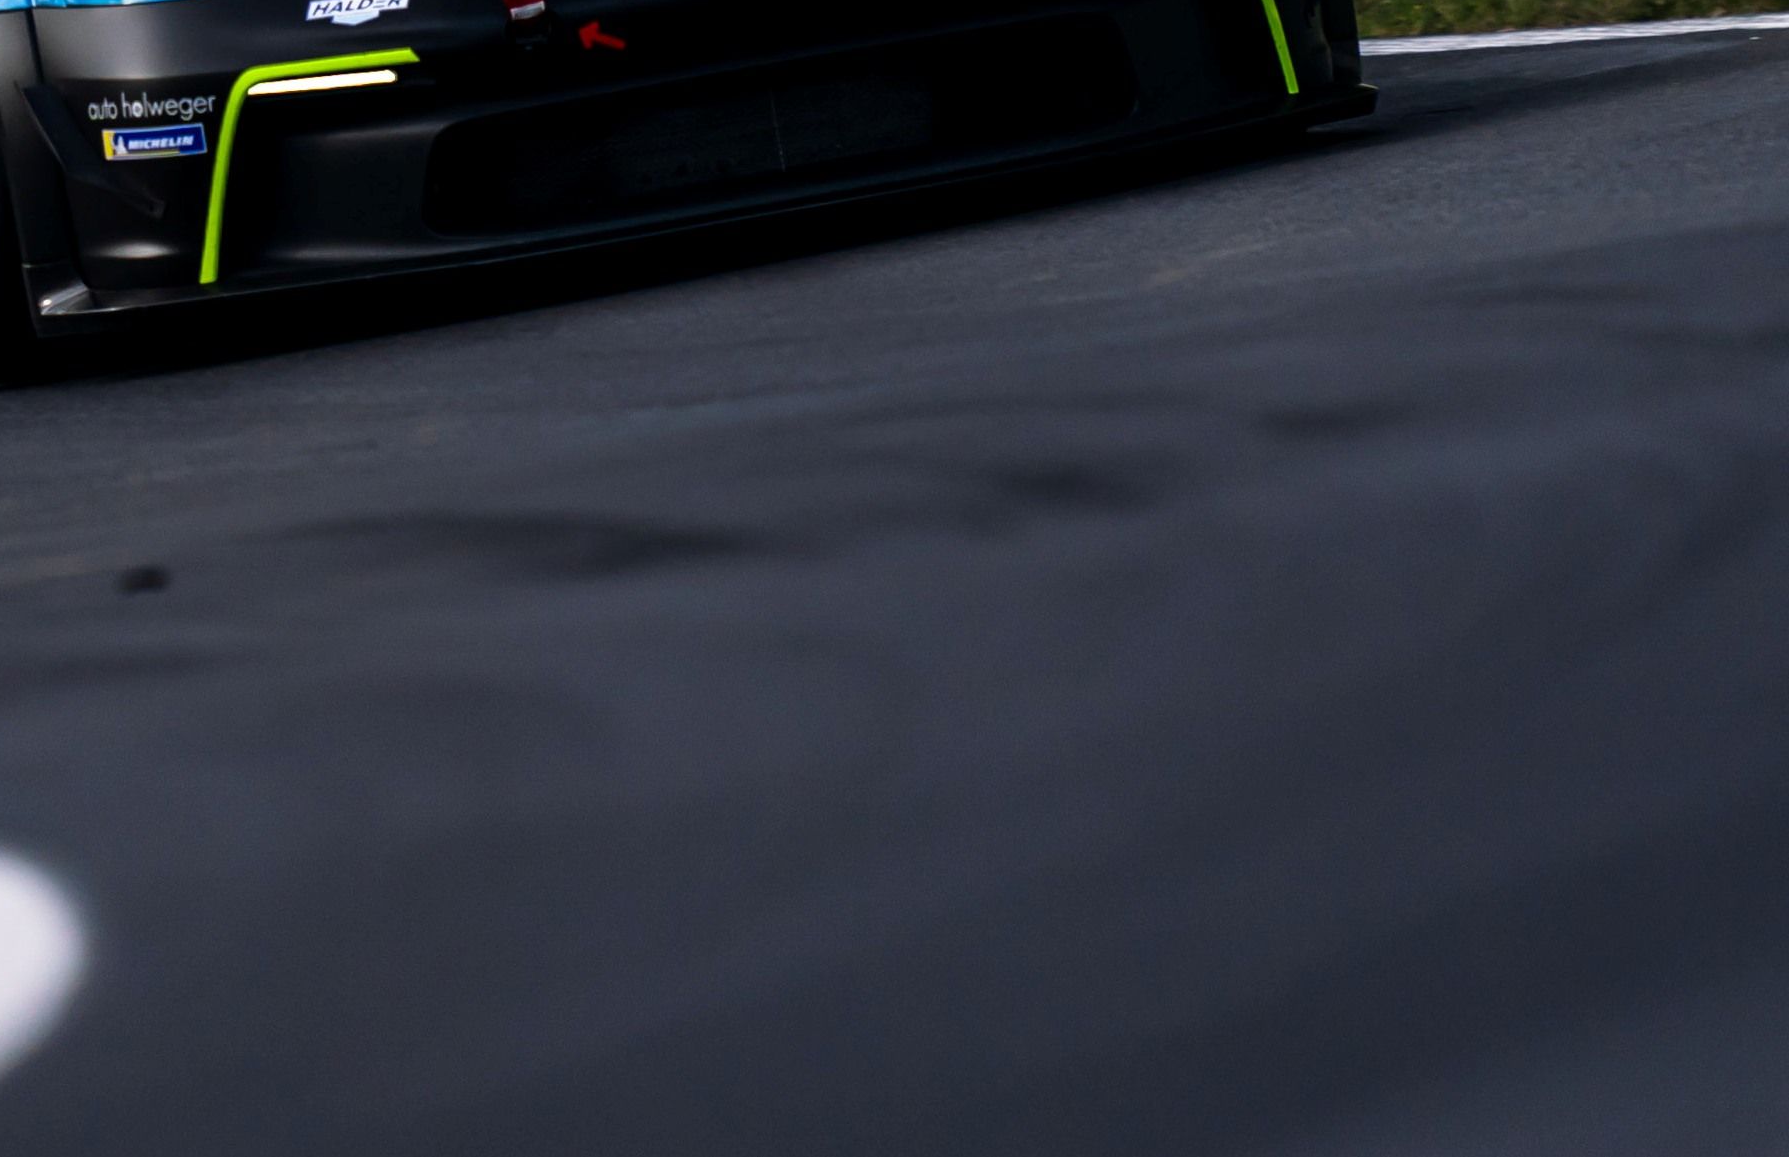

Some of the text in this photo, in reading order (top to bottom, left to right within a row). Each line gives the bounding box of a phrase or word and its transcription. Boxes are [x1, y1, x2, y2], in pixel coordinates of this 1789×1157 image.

[87, 91, 217, 122] auto holweger
[128, 134, 195, 151] MICHELIN
